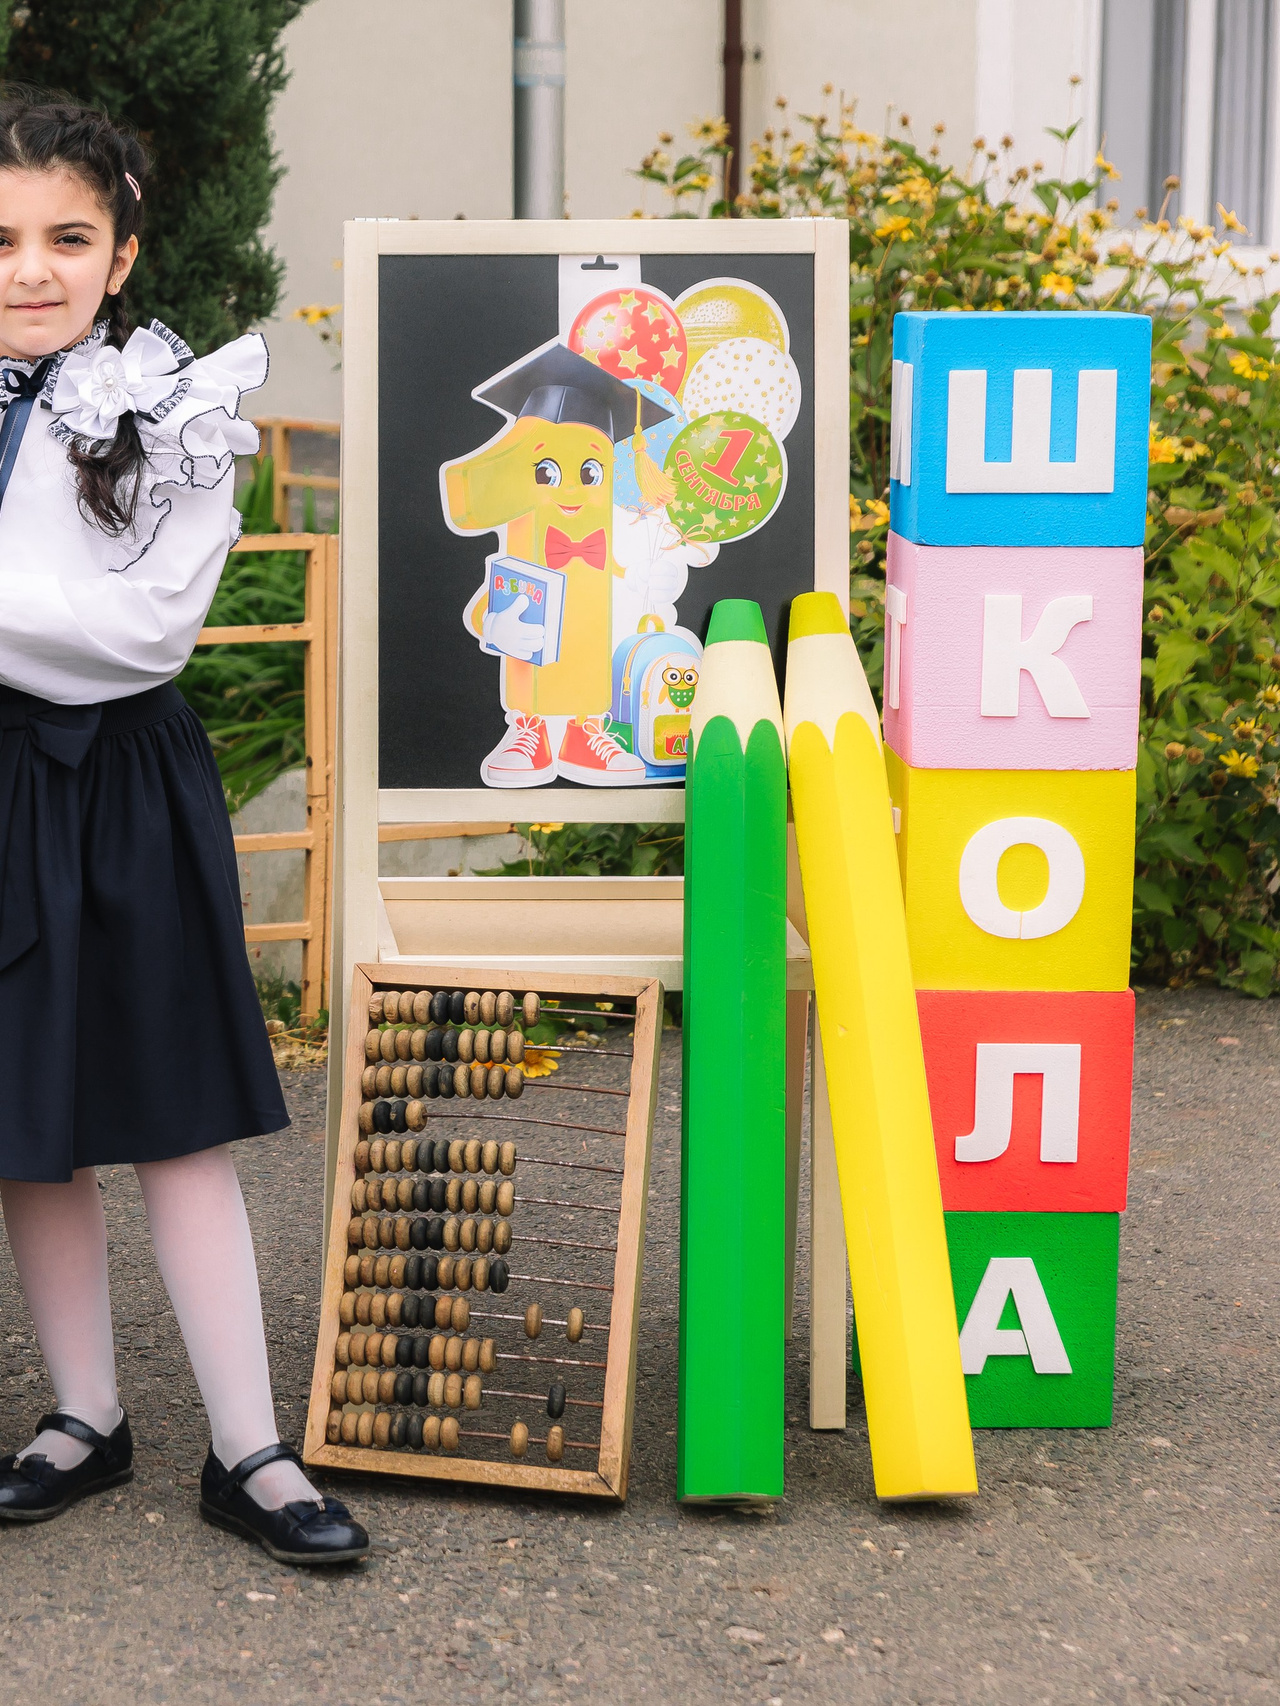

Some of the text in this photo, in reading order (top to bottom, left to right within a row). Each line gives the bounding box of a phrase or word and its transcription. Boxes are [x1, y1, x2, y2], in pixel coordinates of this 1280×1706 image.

[675, 449, 762, 511] СЕНТЯБРЯ
[701, 428, 755, 488] 1
[494, 575, 543, 605] АЗБУКА
